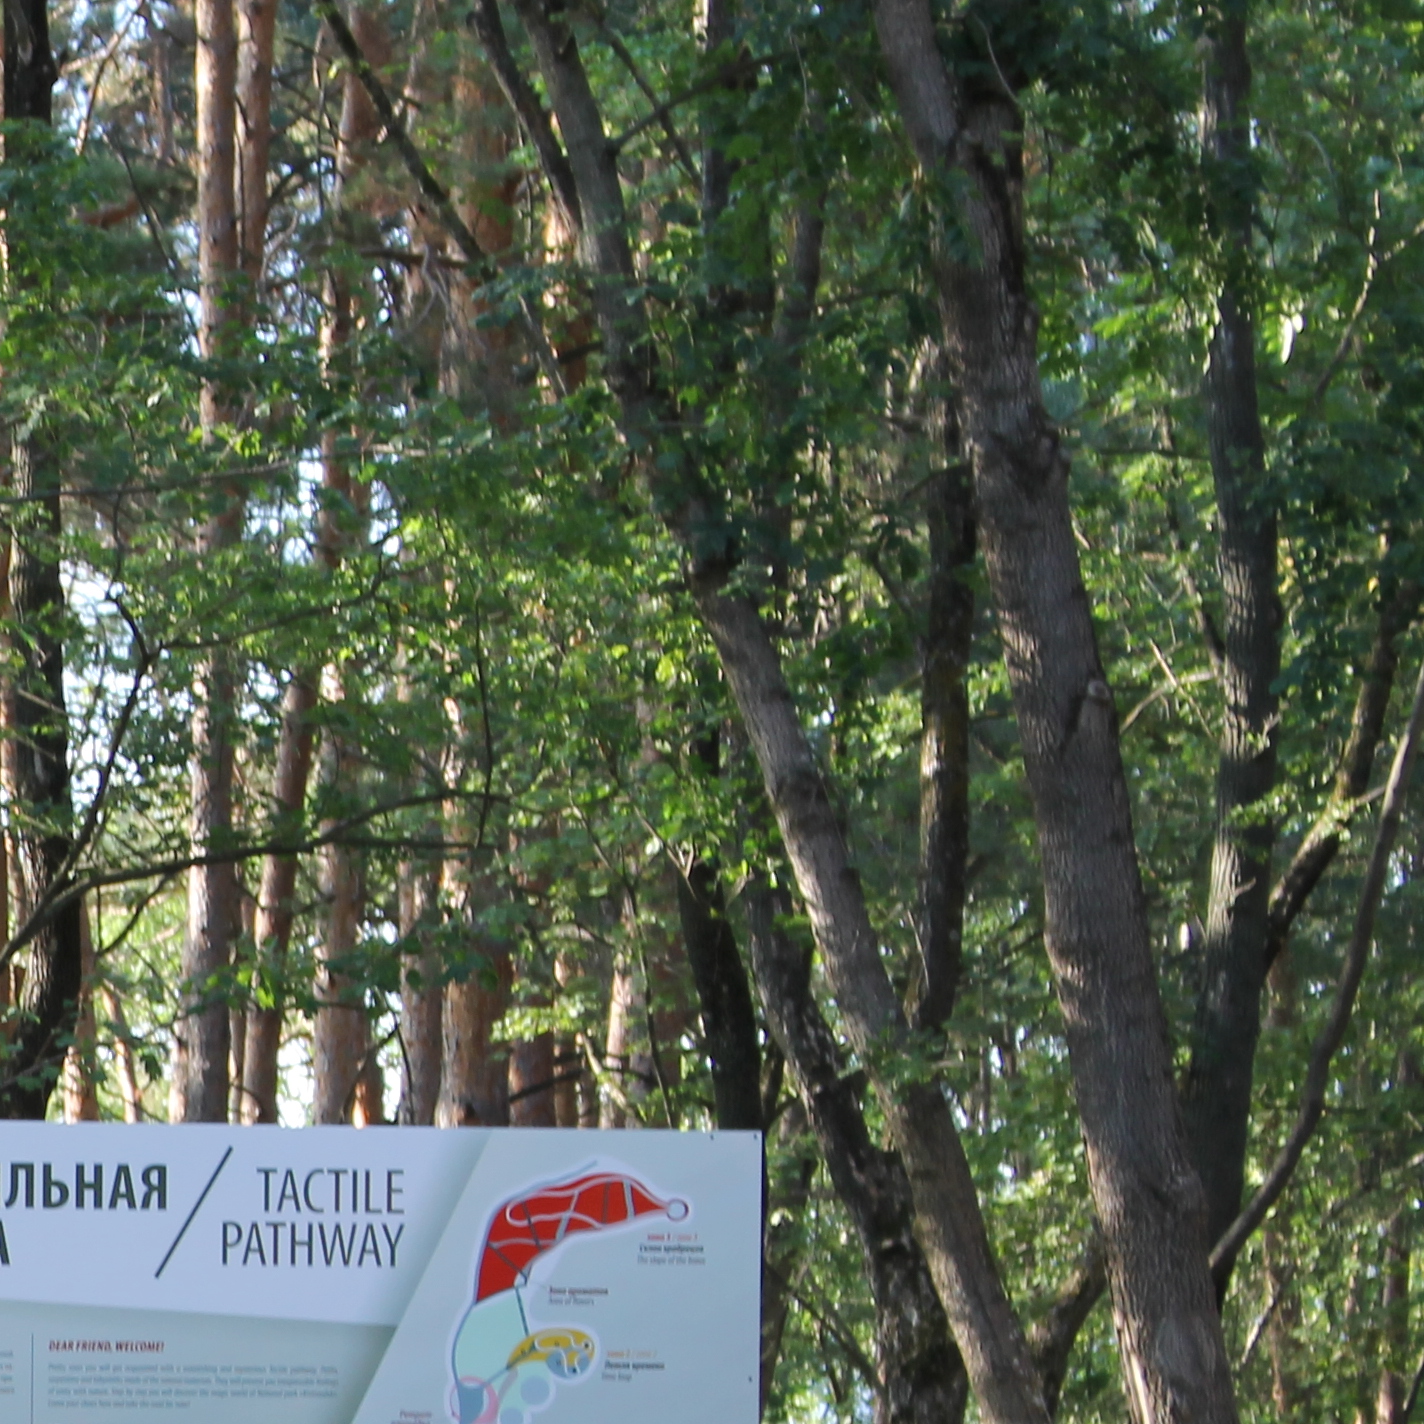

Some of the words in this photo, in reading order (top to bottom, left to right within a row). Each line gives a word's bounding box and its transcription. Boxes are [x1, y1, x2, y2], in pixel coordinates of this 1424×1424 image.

[255, 1167, 405, 1215] TACTILE
[221, 1220, 405, 1268] PATHWAY
[48, 1339, 74, 1352] DEAR
[76, 1340, 112, 1353] FRIEND,
[115, 1340, 165, 1352] WELCOME!
